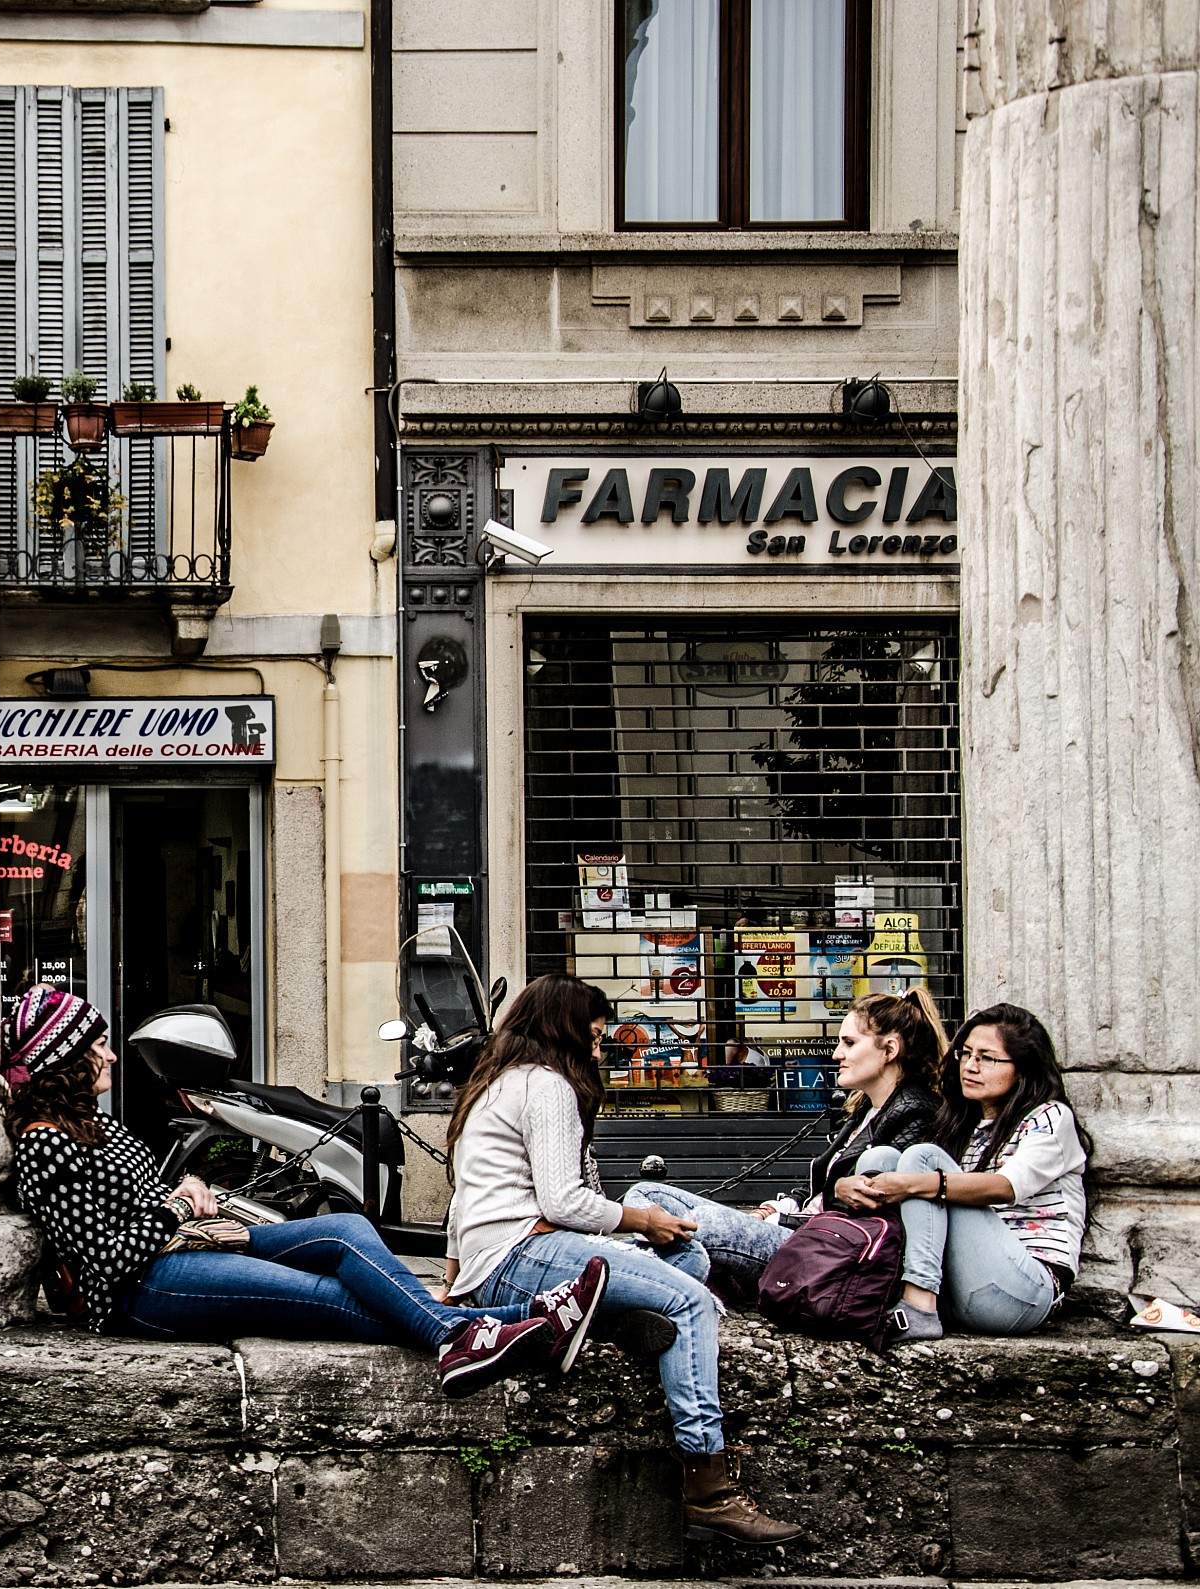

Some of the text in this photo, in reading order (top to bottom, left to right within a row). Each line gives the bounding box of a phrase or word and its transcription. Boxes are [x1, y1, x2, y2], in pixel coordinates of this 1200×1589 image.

[540, 466, 958, 524] FARMACIA
[746, 530, 958, 555] San Lorenzo
[138, 707, 219, 737] UOMO
[105, 744, 154, 757] delle
[160, 743, 266, 757] COLONNE
[883, 917, 912, 928] ALOE
[874, 943, 920, 951] DEPURAIVA
[768, 988, 793, 997] 10,90
[557, 1296, 583, 1331] N
[471, 1327, 501, 1350] N
